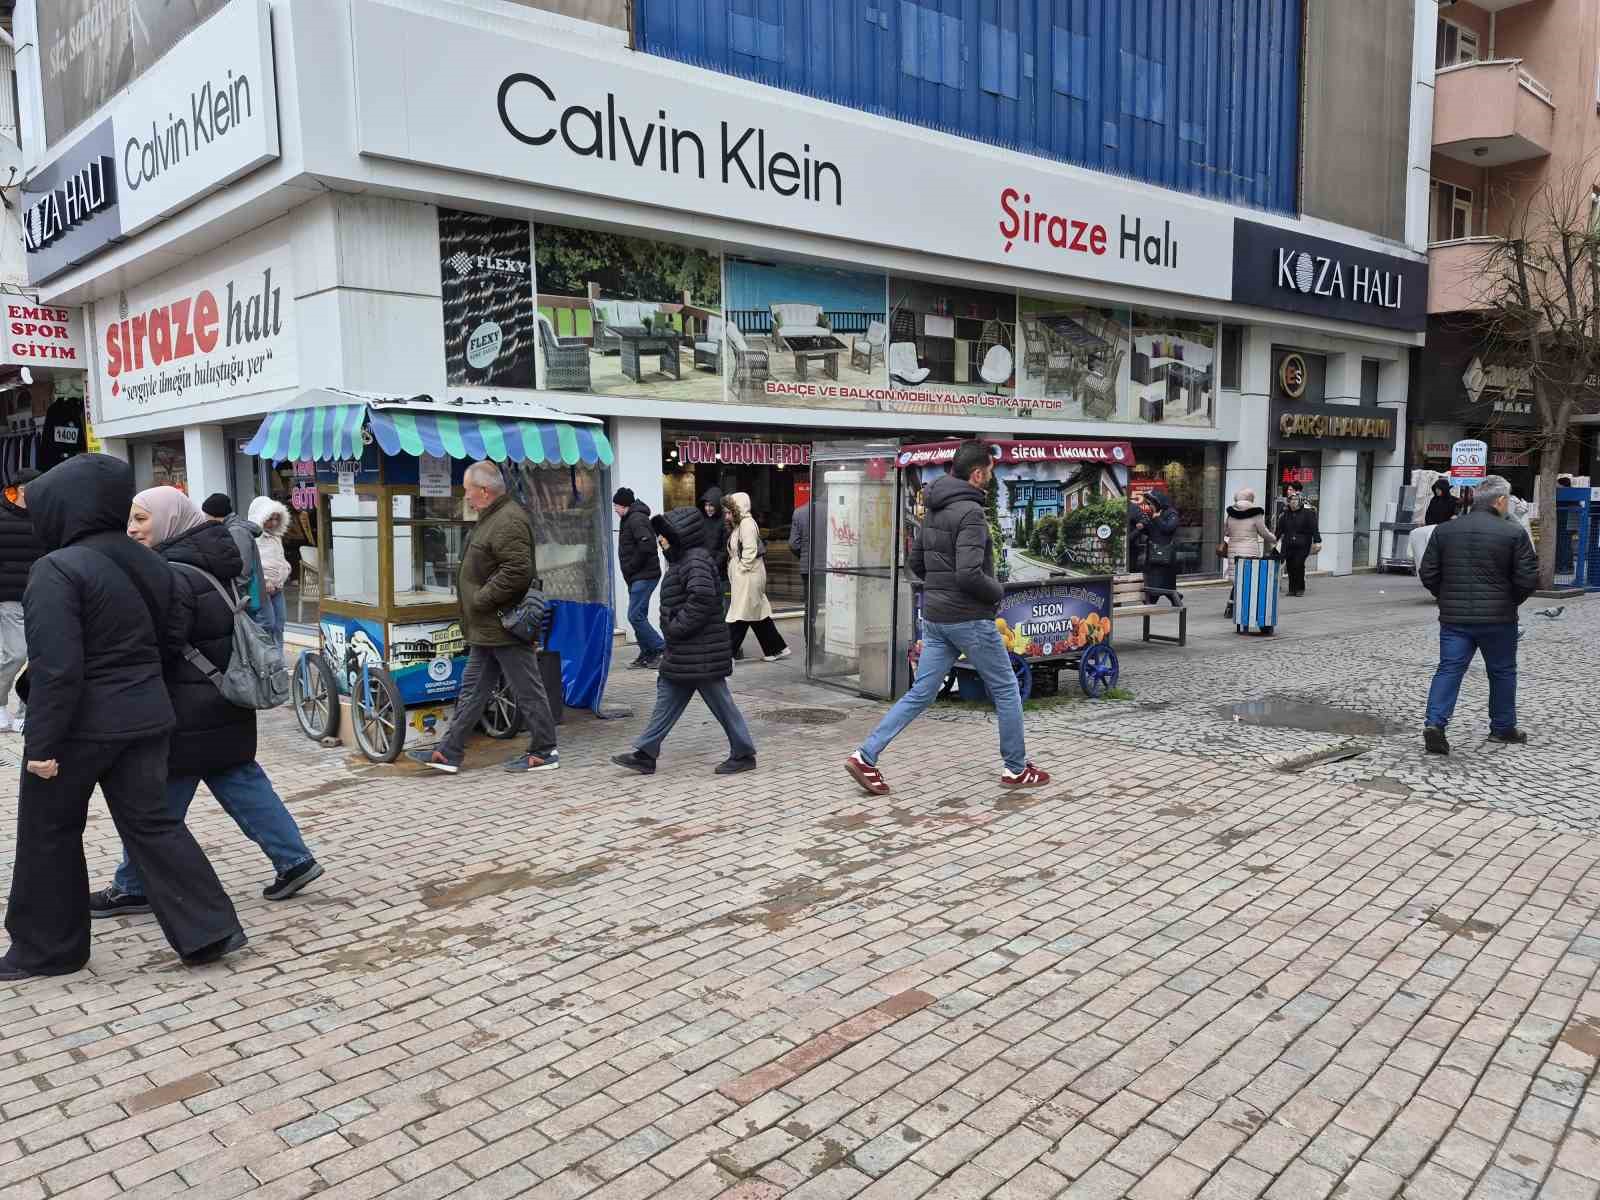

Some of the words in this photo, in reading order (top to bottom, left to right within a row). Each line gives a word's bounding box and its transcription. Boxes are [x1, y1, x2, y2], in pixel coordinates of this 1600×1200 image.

[125, 112, 189, 190] Calvin
[191, 69, 251, 151] Klein
[497, 72, 705, 179] Calvin
[720, 121, 842, 206] Klein
[64, 155, 105, 225] HALI
[999, 187, 1107, 256] Şiraze
[1119, 213, 1177, 269] Halı
[477, 255, 527, 273] FLEXY
[1278, 247, 1345, 299] KOZA
[1352, 264, 1402, 309] HALI
[8, 305, 69, 322] EMRE
[225, 267, 282, 347] halı
[11, 322, 69, 339] SPOR
[470, 330, 499, 351] FLEXY
[12, 340, 76, 360] GİYİM
[767, 382, 816, 398] BAHÇE
[819, 386, 837, 397] VE
[839, 387, 895, 400] BALKON
[897, 390, 978, 404] MOBİLYALARI
[677, 435, 716, 464] TÜM
[1011, 443, 1047, 459] SİFON
[1053, 444, 1108, 459] LİMONATA
